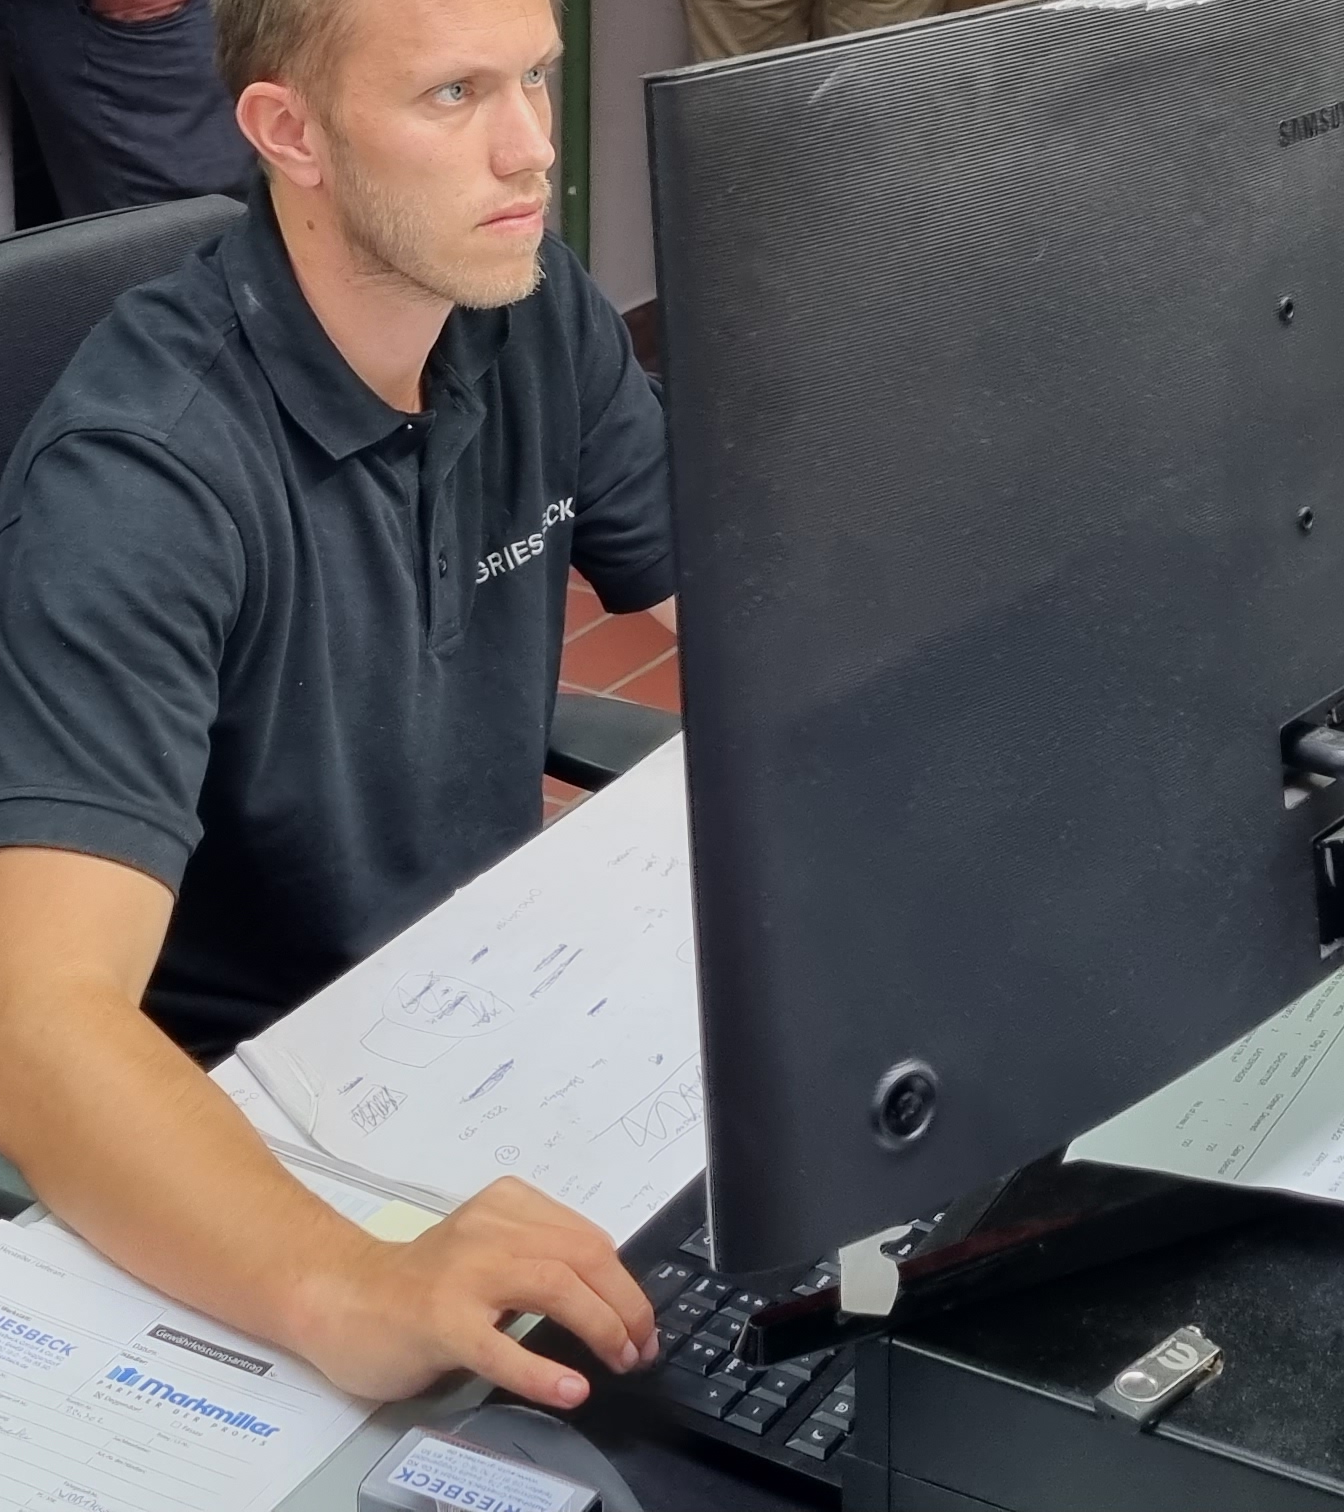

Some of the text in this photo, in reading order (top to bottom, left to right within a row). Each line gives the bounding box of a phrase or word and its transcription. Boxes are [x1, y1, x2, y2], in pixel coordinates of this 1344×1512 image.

[156, 1328, 263, 1374] Gewährleistungsantrag
[96, 1380, 267, 1447] PARTNER DER PROFIS
[390, 1466, 525, 1512] RIESBECK
